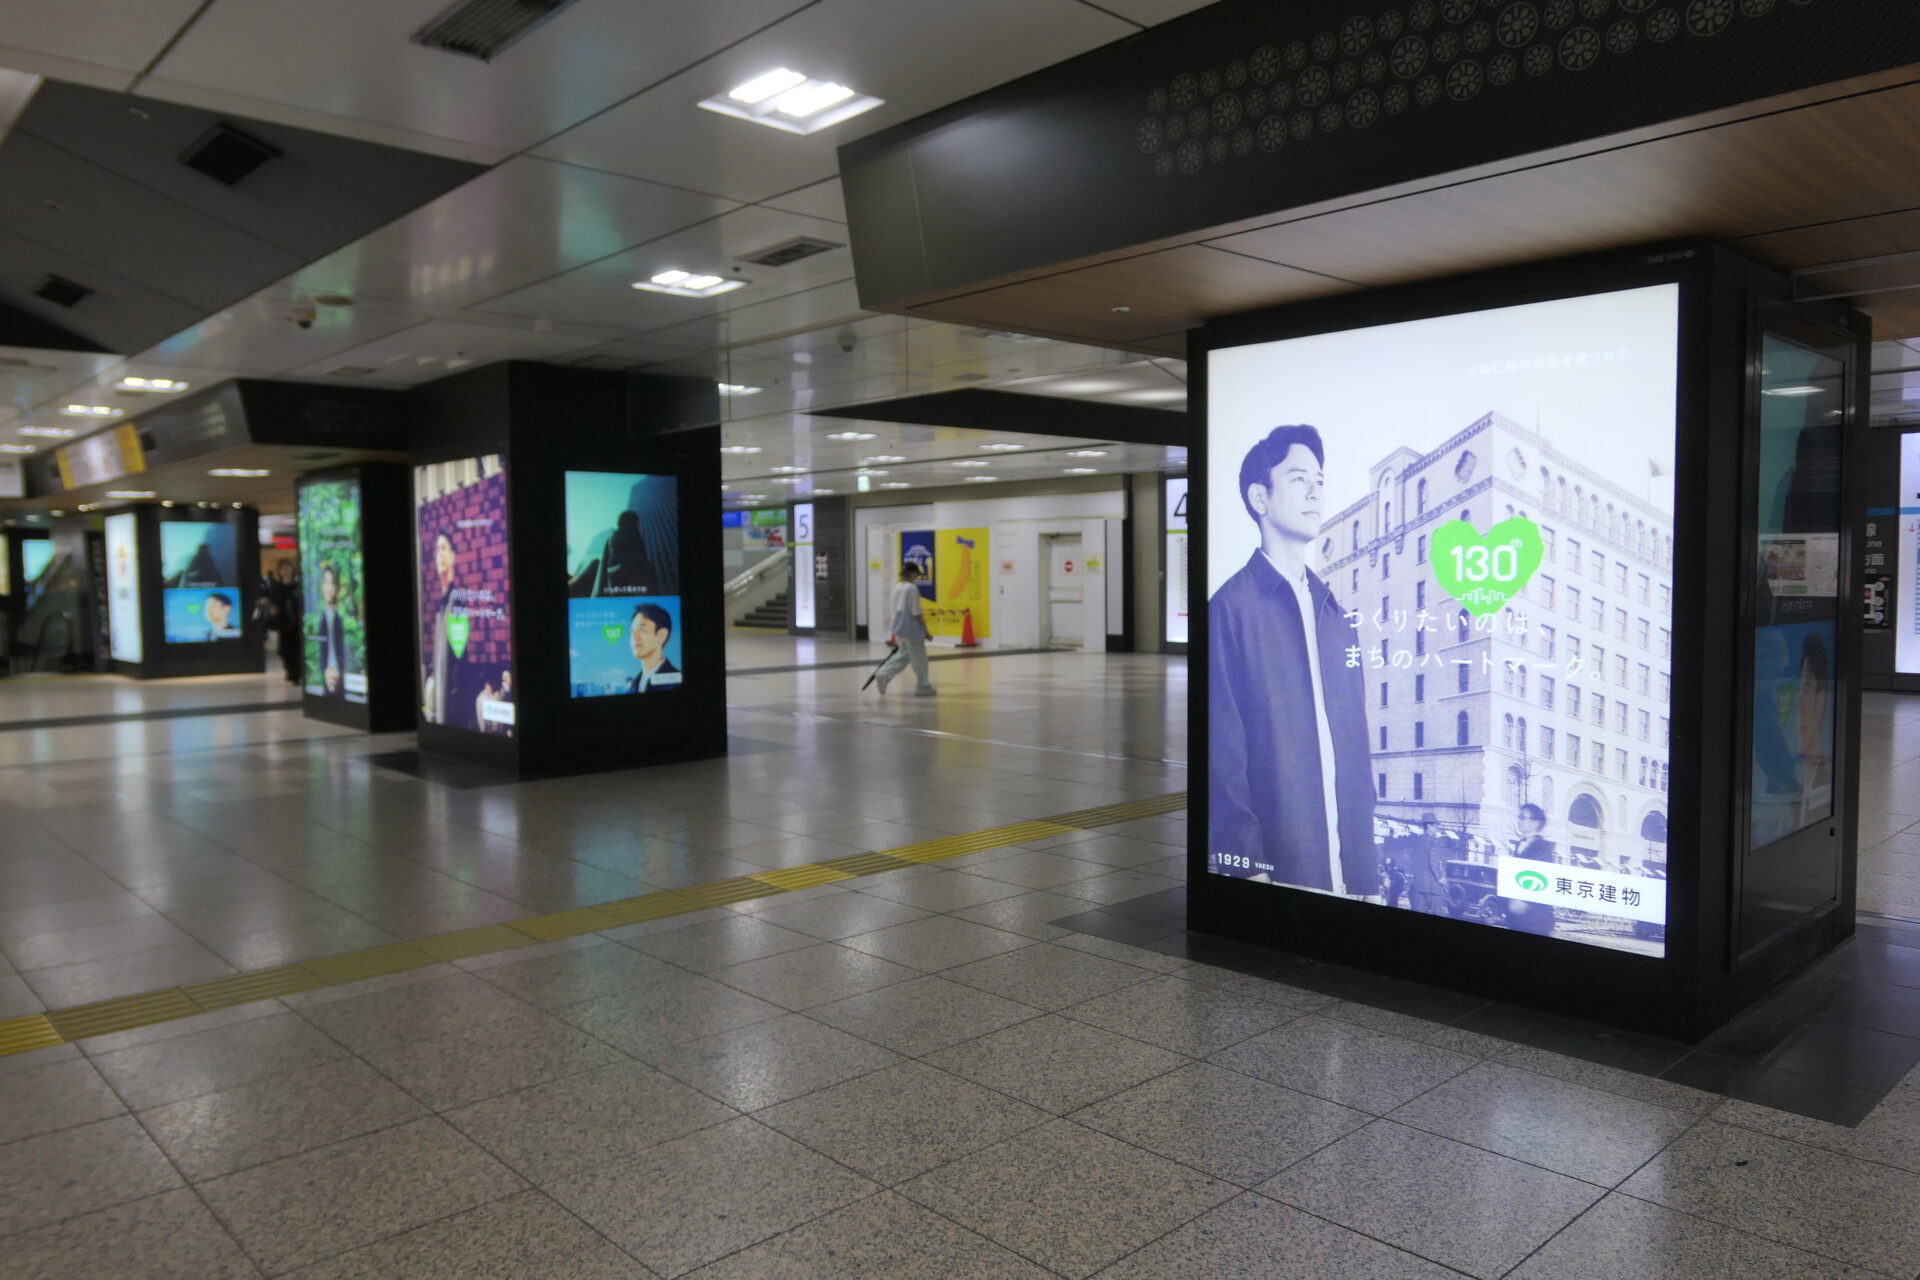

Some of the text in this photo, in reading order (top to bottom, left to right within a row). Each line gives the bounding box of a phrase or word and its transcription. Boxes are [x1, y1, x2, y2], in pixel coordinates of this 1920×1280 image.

[799, 514, 808, 539] 5
[1344, 608, 1547, 634] つくりたいのは、
[1345, 644, 1601, 681] まちのハートマーク。
[1217, 852, 1275, 871] 1929 YAESU
[1555, 877, 1641, 907] 東京建物
